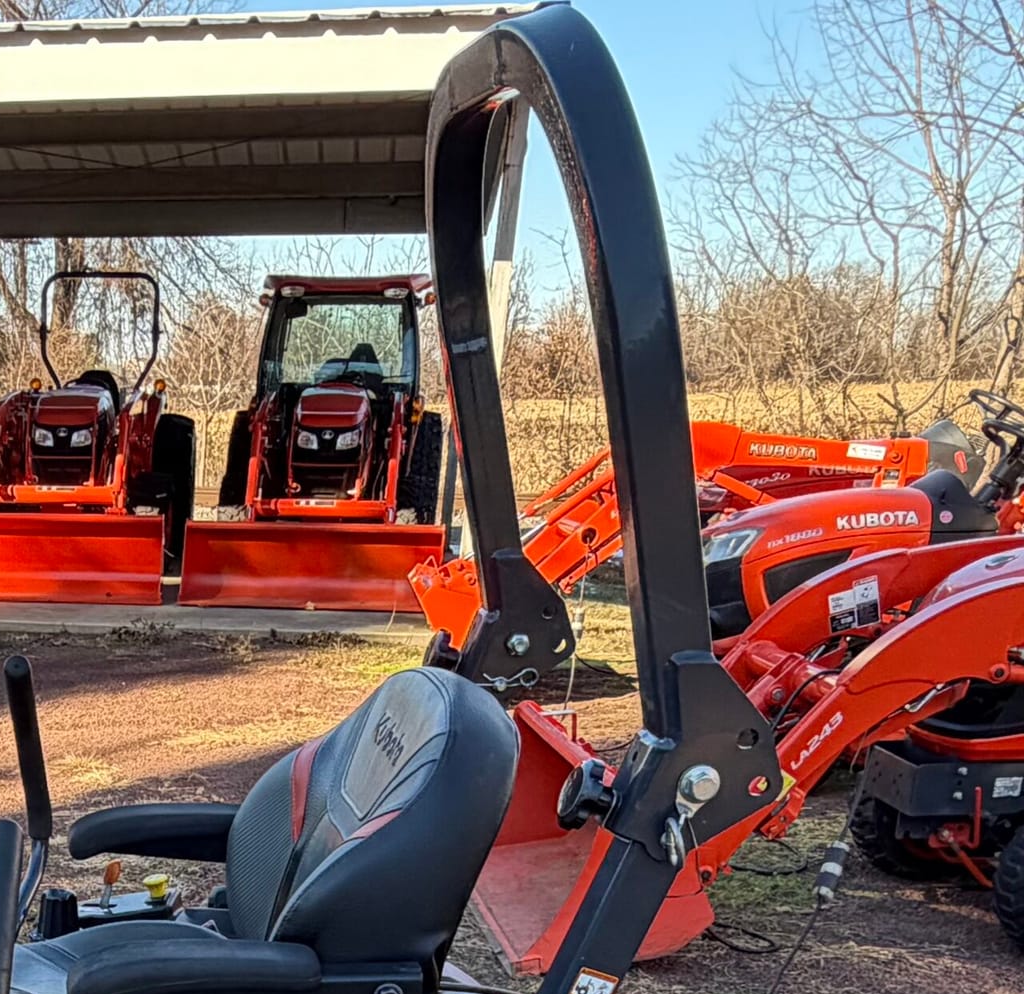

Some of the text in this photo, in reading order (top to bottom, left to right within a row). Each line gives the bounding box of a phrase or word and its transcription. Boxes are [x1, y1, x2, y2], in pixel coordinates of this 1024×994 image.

[749, 443, 817, 460] KUBOTA
[837, 511, 919, 530] KUBOTA
[374, 712, 405, 766] Kubota
[790, 711, 844, 770] LA243
